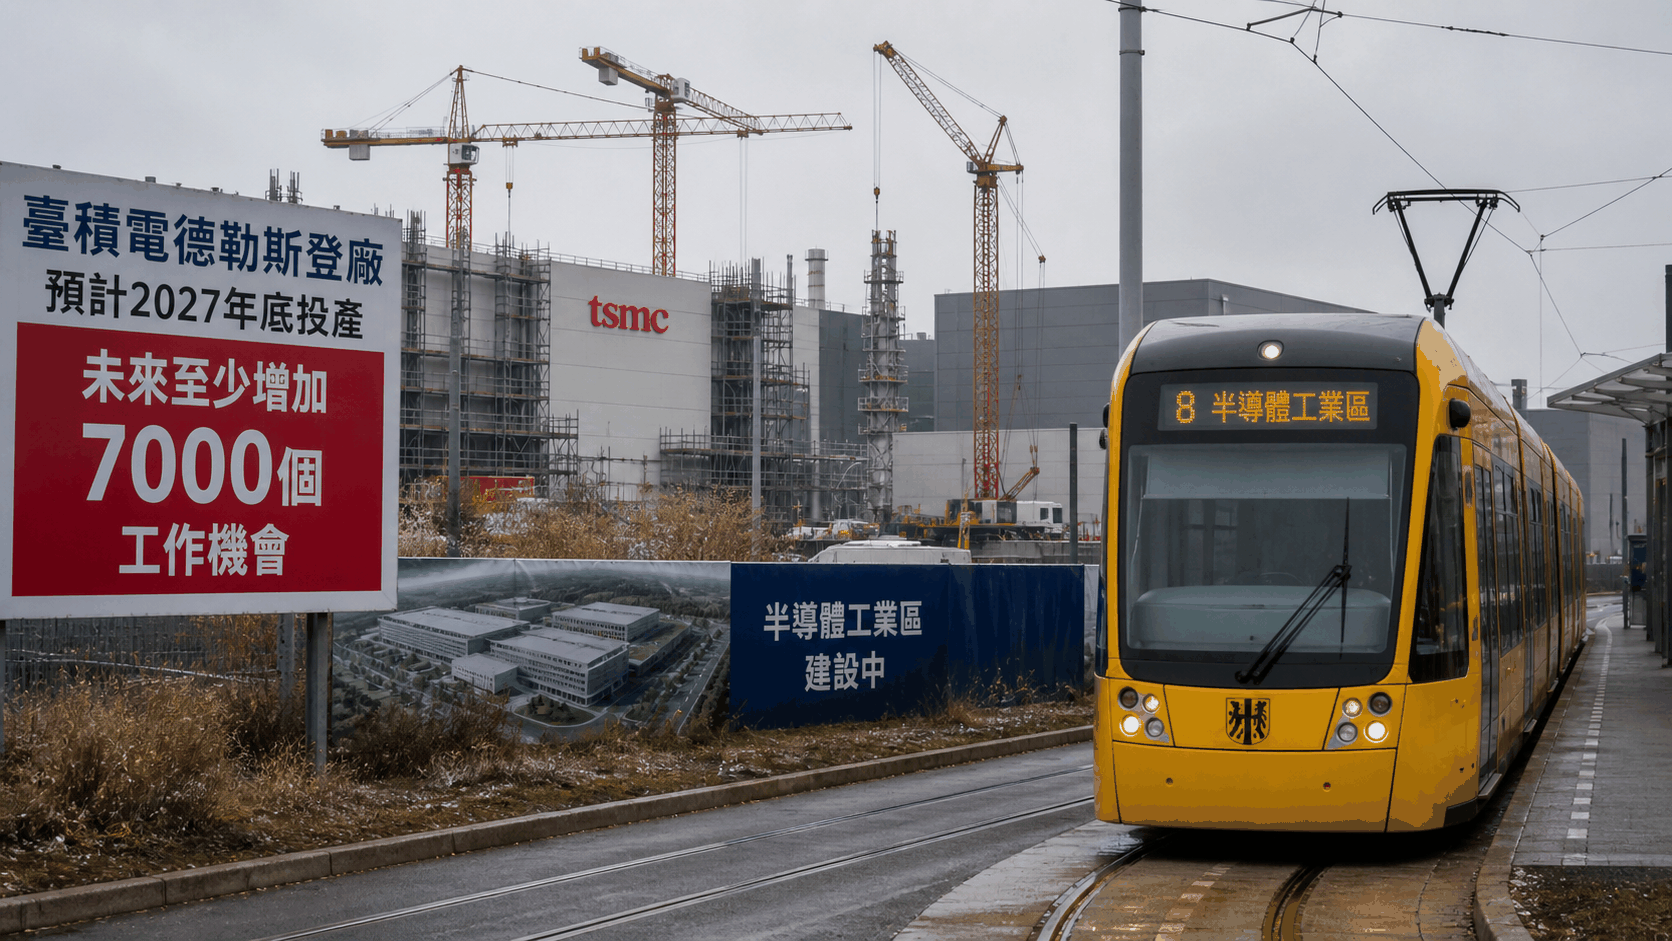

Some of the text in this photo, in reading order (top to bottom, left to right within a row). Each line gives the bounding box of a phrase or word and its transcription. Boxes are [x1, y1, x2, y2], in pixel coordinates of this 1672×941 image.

[22, 194, 384, 286] 臺積電德勒斯登廠
[45, 268, 363, 339] 預計2027年底投產
[588, 295, 669, 334] tsmc
[82, 348, 327, 413] 未來至少增加
[1176, 390, 1370, 423] 8 半導體工業區
[82, 422, 322, 506] 7000個
[119, 523, 289, 576] 工作機會
[764, 600, 922, 641] 半導體工業區
[805, 651, 885, 692] 建設中
